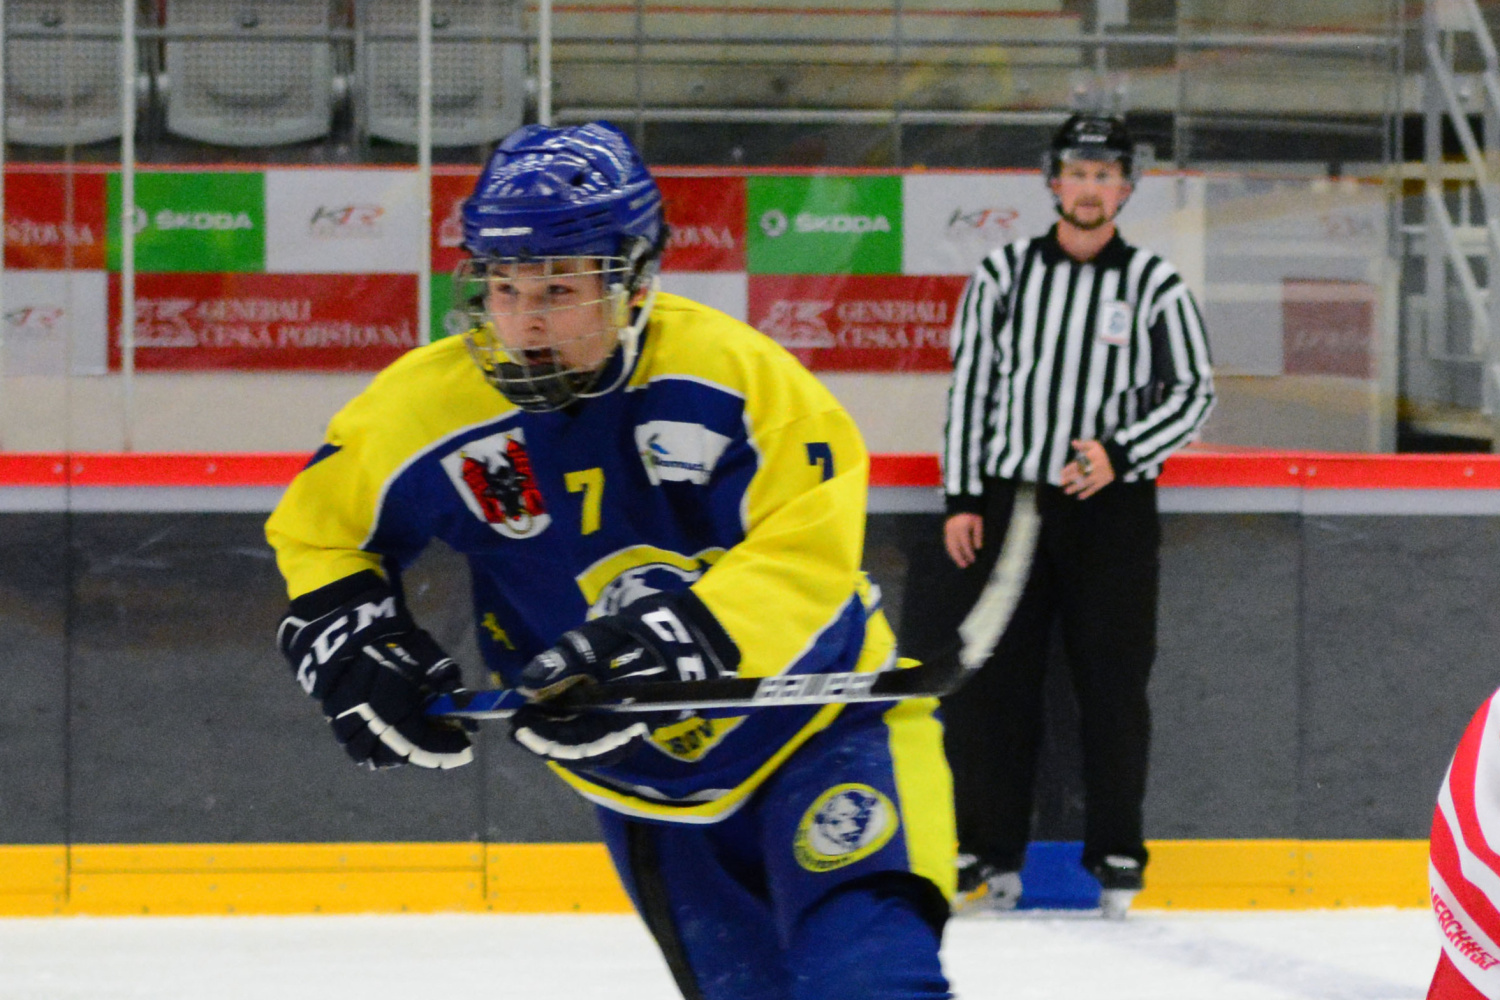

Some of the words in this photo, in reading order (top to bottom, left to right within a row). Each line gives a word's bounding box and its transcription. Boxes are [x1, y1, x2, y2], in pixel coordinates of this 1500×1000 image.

[154, 207, 253, 231] ŠKODA
[794, 208, 892, 233] ŠKODA
[836, 300, 947, 322] GENERALI
[565, 468, 605, 535] 7
[297, 597, 397, 694] CCM
